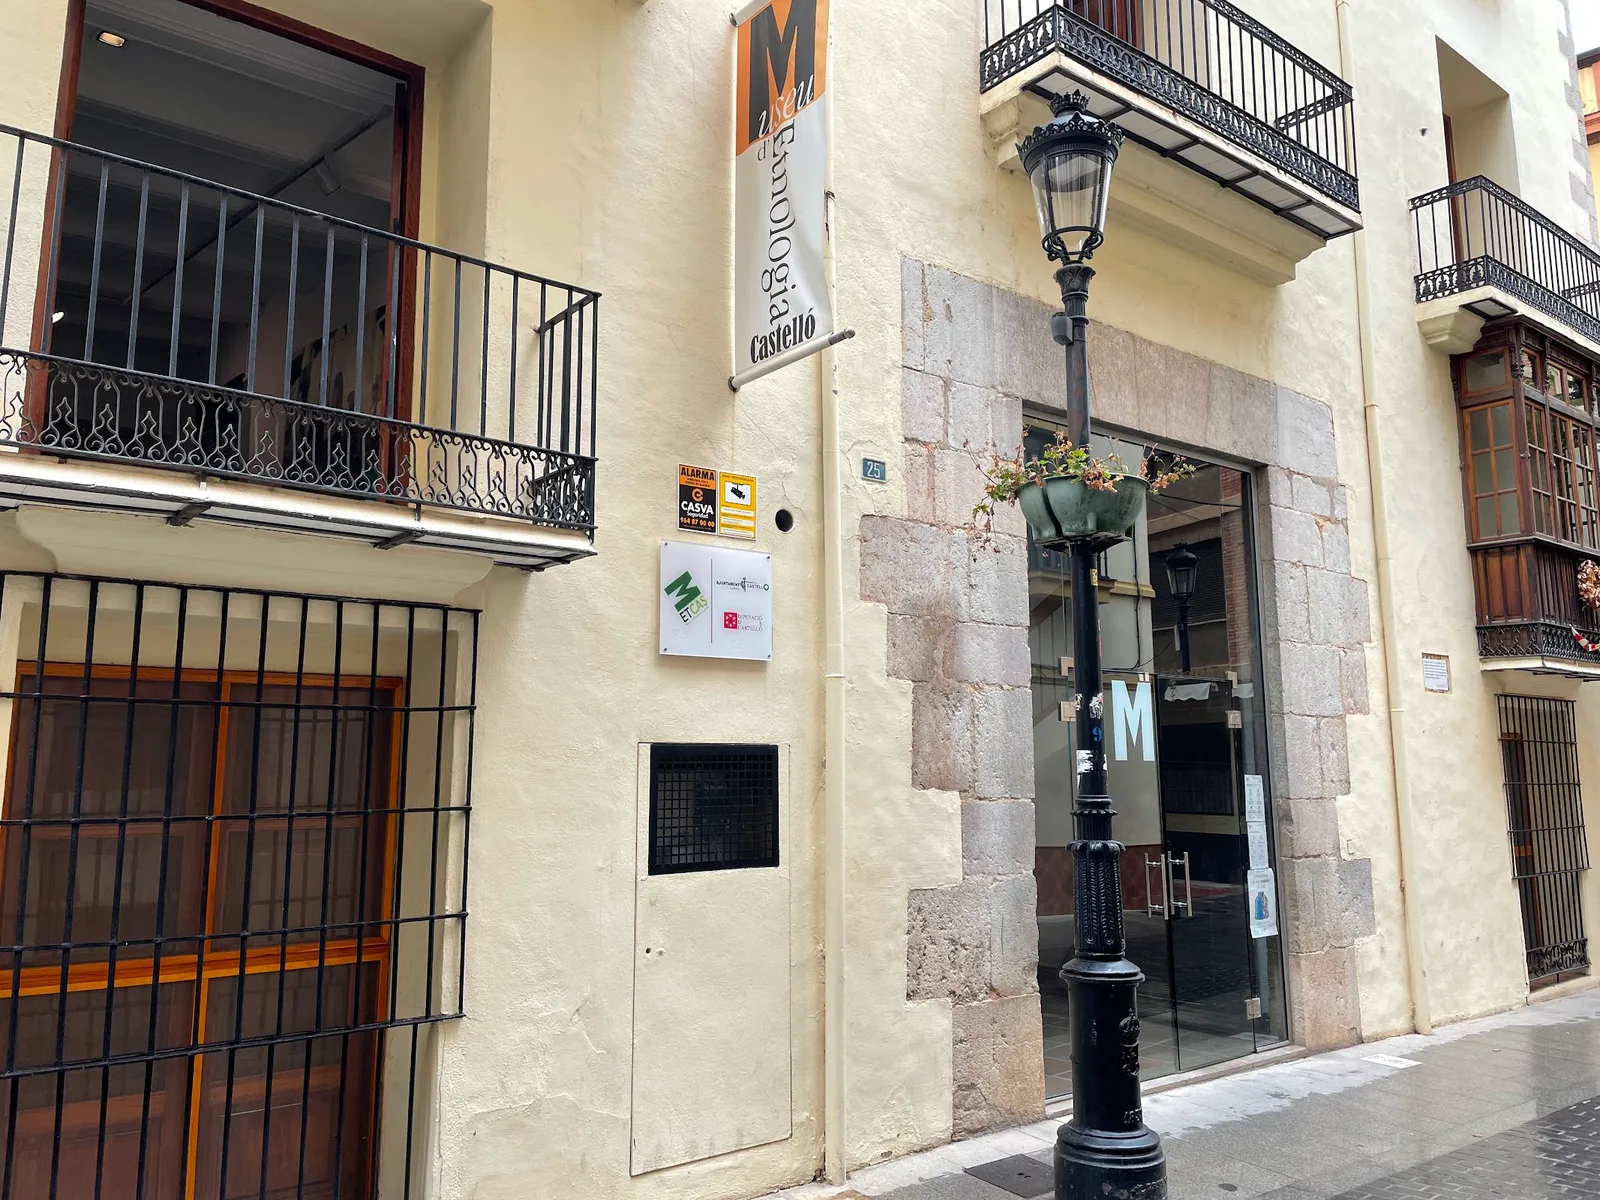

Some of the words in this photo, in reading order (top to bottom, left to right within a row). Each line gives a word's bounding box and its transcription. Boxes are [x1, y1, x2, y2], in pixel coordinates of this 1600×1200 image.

[750, 308, 817, 364] Castelló
[681, 467, 715, 481] ALARMA
[867, 461, 880, 478] 25
[681, 501, 714, 515] CASVA
[686, 511, 709, 519] Seguridad
[680, 516, 691, 524] 964
[699, 519, 707, 527] 00
[707, 520, 715, 528] 00
[716, 580, 740, 588] AJUNTAMENT
[1112, 680, 1155, 762] M
